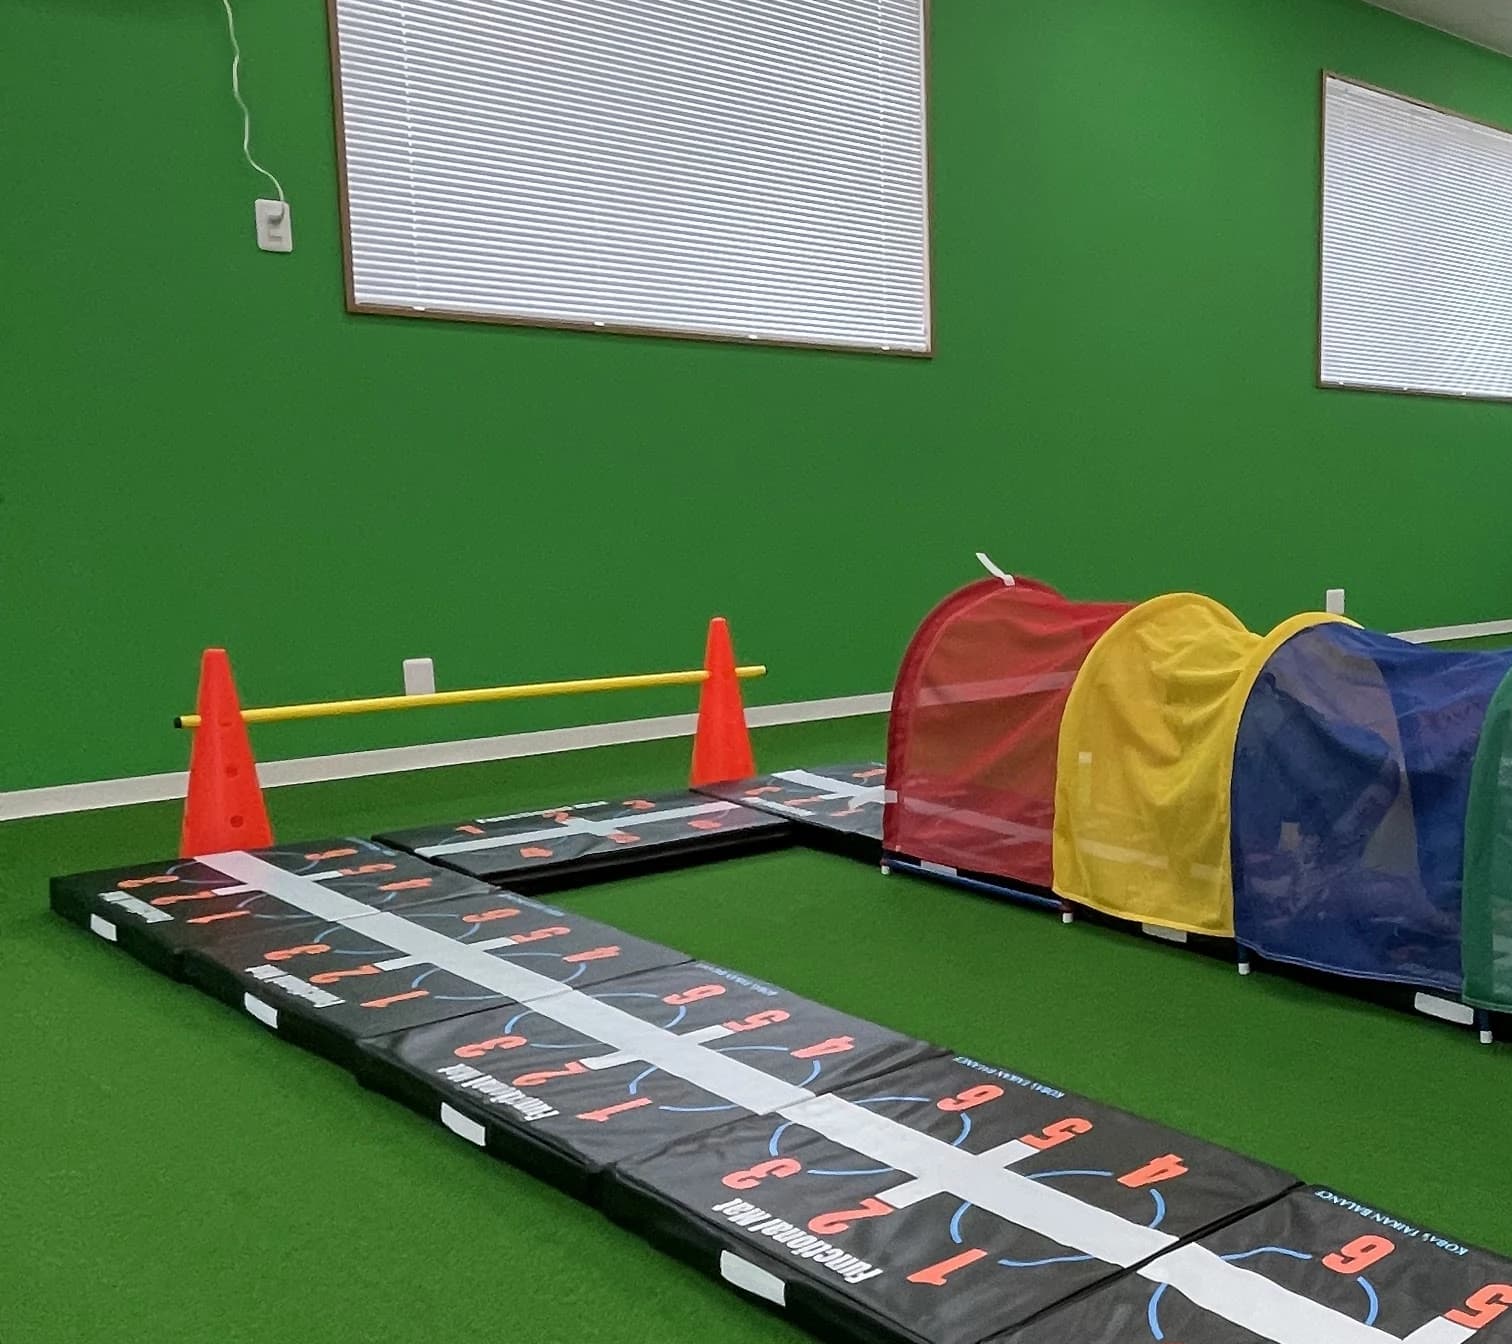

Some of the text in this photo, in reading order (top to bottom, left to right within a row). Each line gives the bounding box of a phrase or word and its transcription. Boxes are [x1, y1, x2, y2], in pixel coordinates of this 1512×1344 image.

[936, 1083, 1005, 1112] 6
[1020, 1117, 1094, 1151] 5
[721, 1157, 802, 1190] 3
[1116, 1152, 1189, 1189] 4
[806, 1197, 895, 1236] 2
[747, 1217, 884, 1284] Functional
[906, 1248, 988, 1287] 1
[1321, 1233, 1395, 1275] 6
